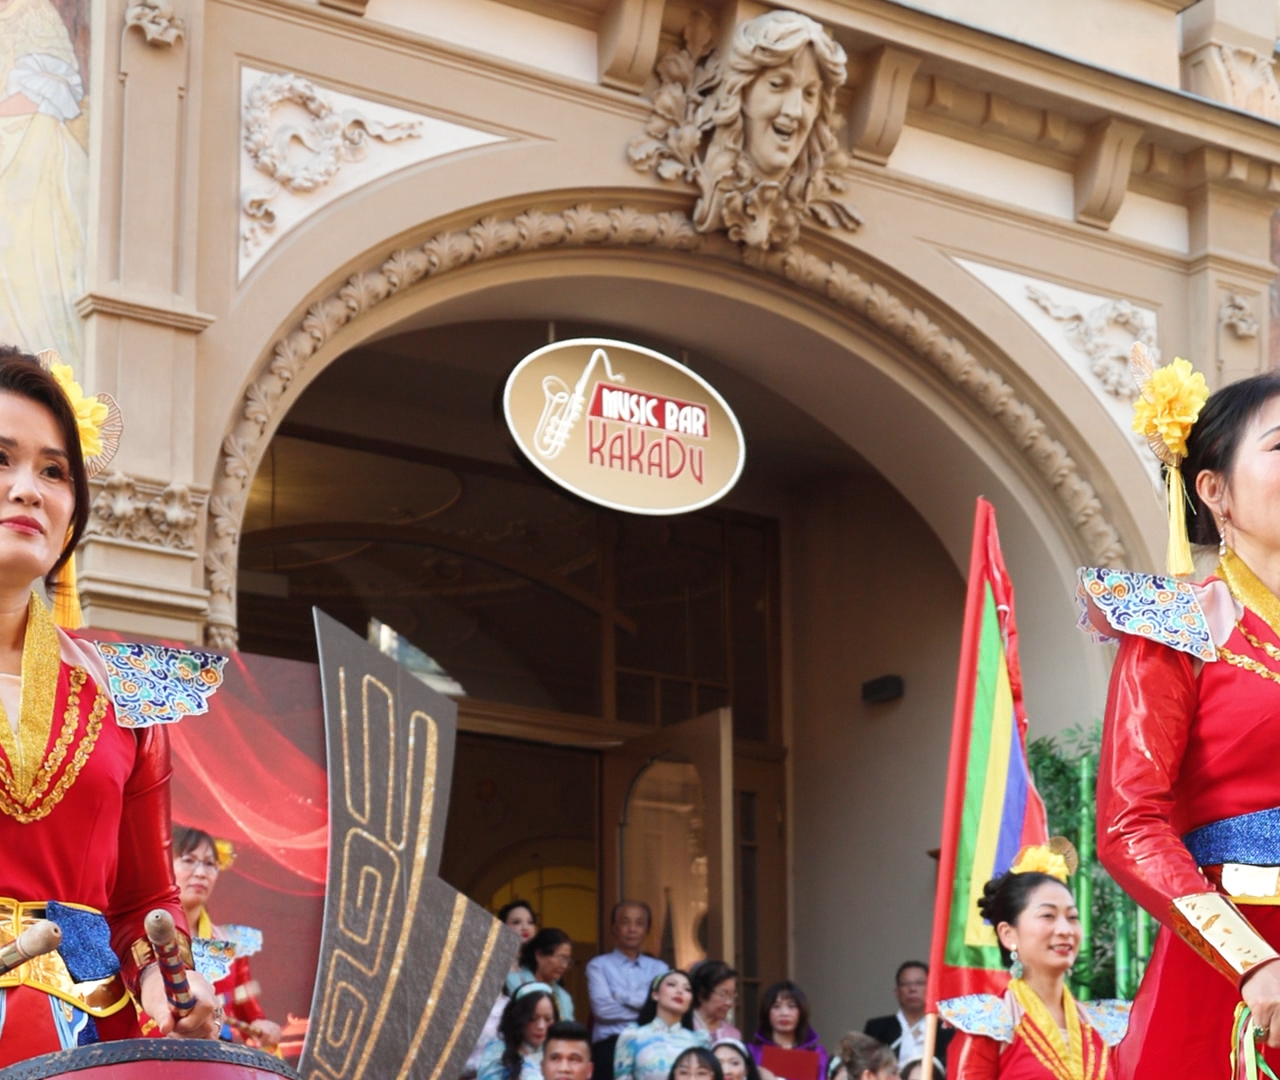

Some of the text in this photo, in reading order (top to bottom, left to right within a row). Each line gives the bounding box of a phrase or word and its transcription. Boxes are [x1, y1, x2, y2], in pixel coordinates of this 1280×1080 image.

[602, 388, 706, 437] MUSIC BAR
[588, 419, 704, 485] KAKADU
